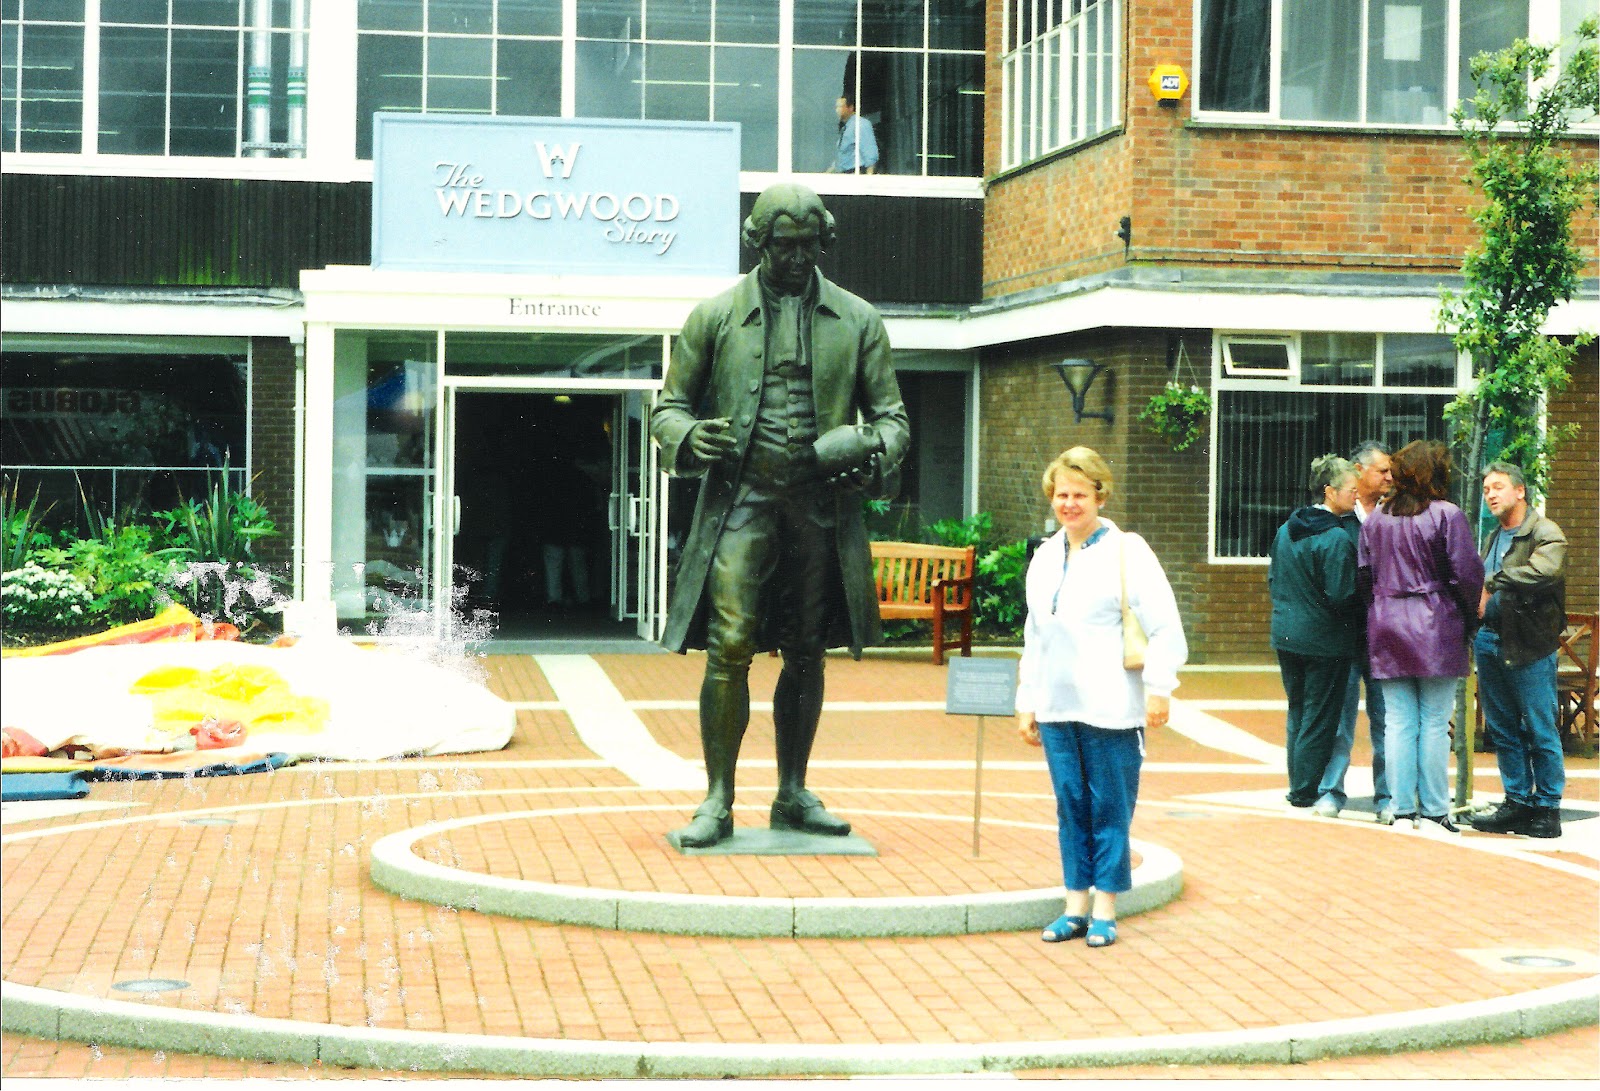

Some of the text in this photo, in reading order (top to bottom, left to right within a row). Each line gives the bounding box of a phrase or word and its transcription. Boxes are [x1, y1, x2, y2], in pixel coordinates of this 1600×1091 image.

[1161, 77, 1179, 88] ADT
[434, 161, 484, 188] The
[435, 188, 680, 222] WEDGWOOD
[603, 217, 677, 255] Story
[508, 297, 602, 317] Entrance
